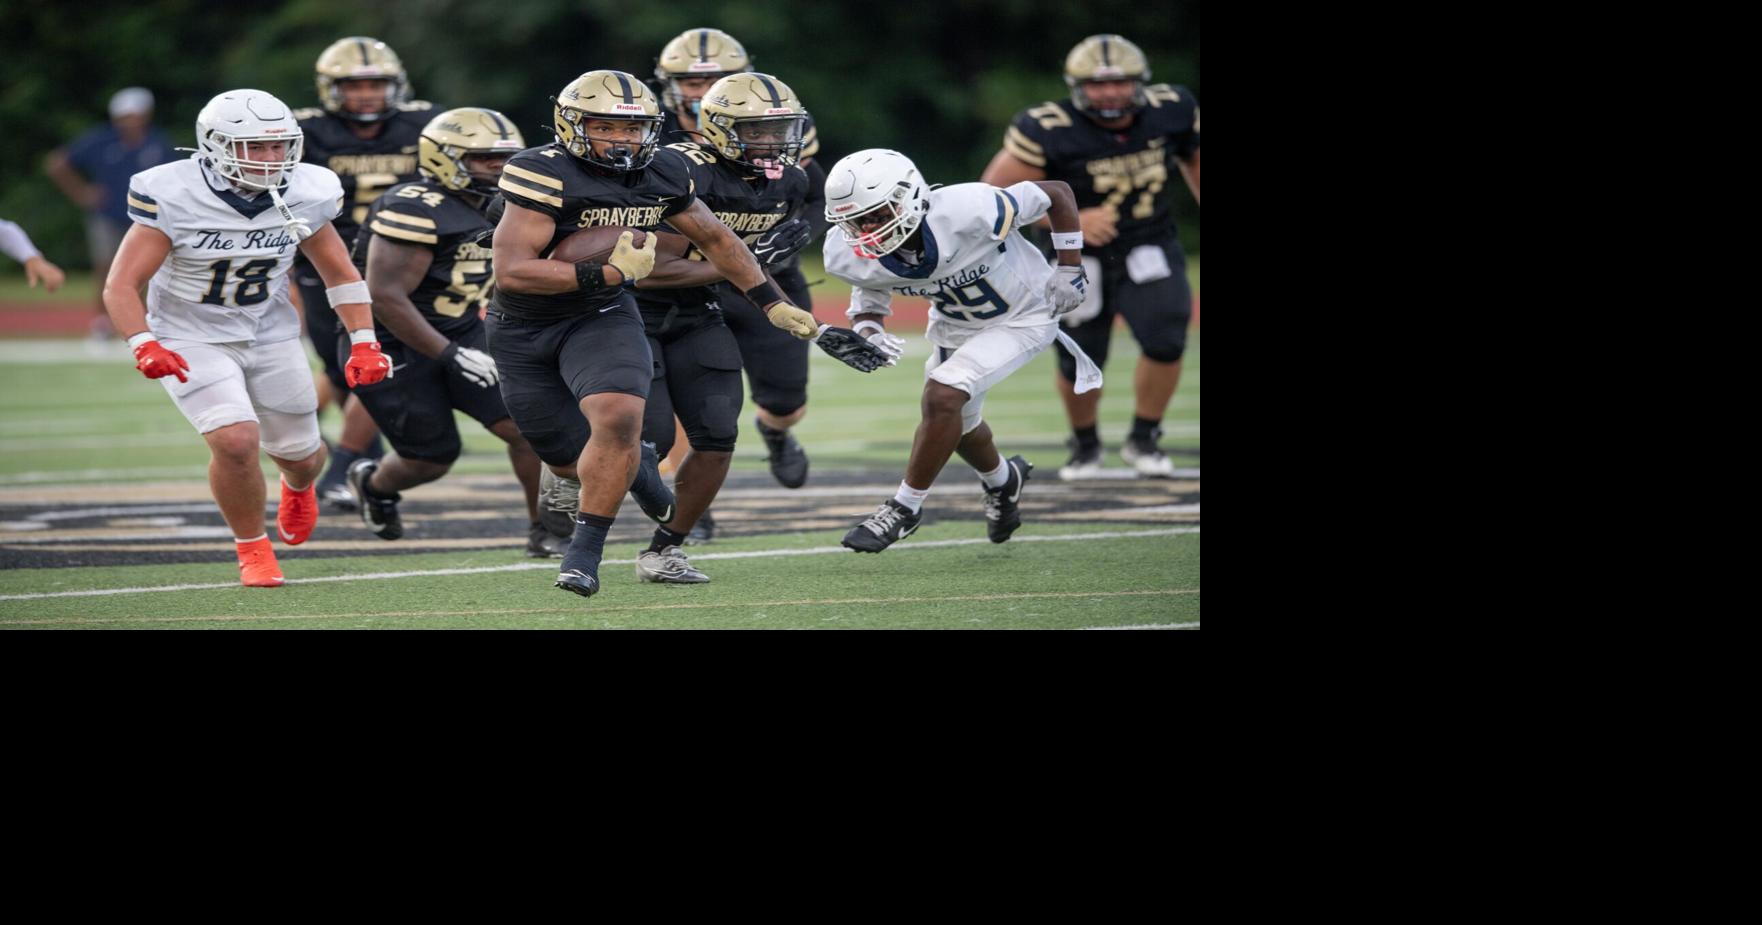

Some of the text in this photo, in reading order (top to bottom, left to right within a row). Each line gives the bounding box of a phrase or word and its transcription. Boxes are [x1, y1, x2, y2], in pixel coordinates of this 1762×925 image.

[395, 185, 446, 208] 54
[1093, 163, 1167, 219] 77
[577, 205, 668, 228] SPRAYBERRY
[192, 229, 298, 253] The Ridg
[201, 258, 279, 306] 18
[892, 264, 990, 297] The Ridge
[936, 277, 1009, 322] 29
